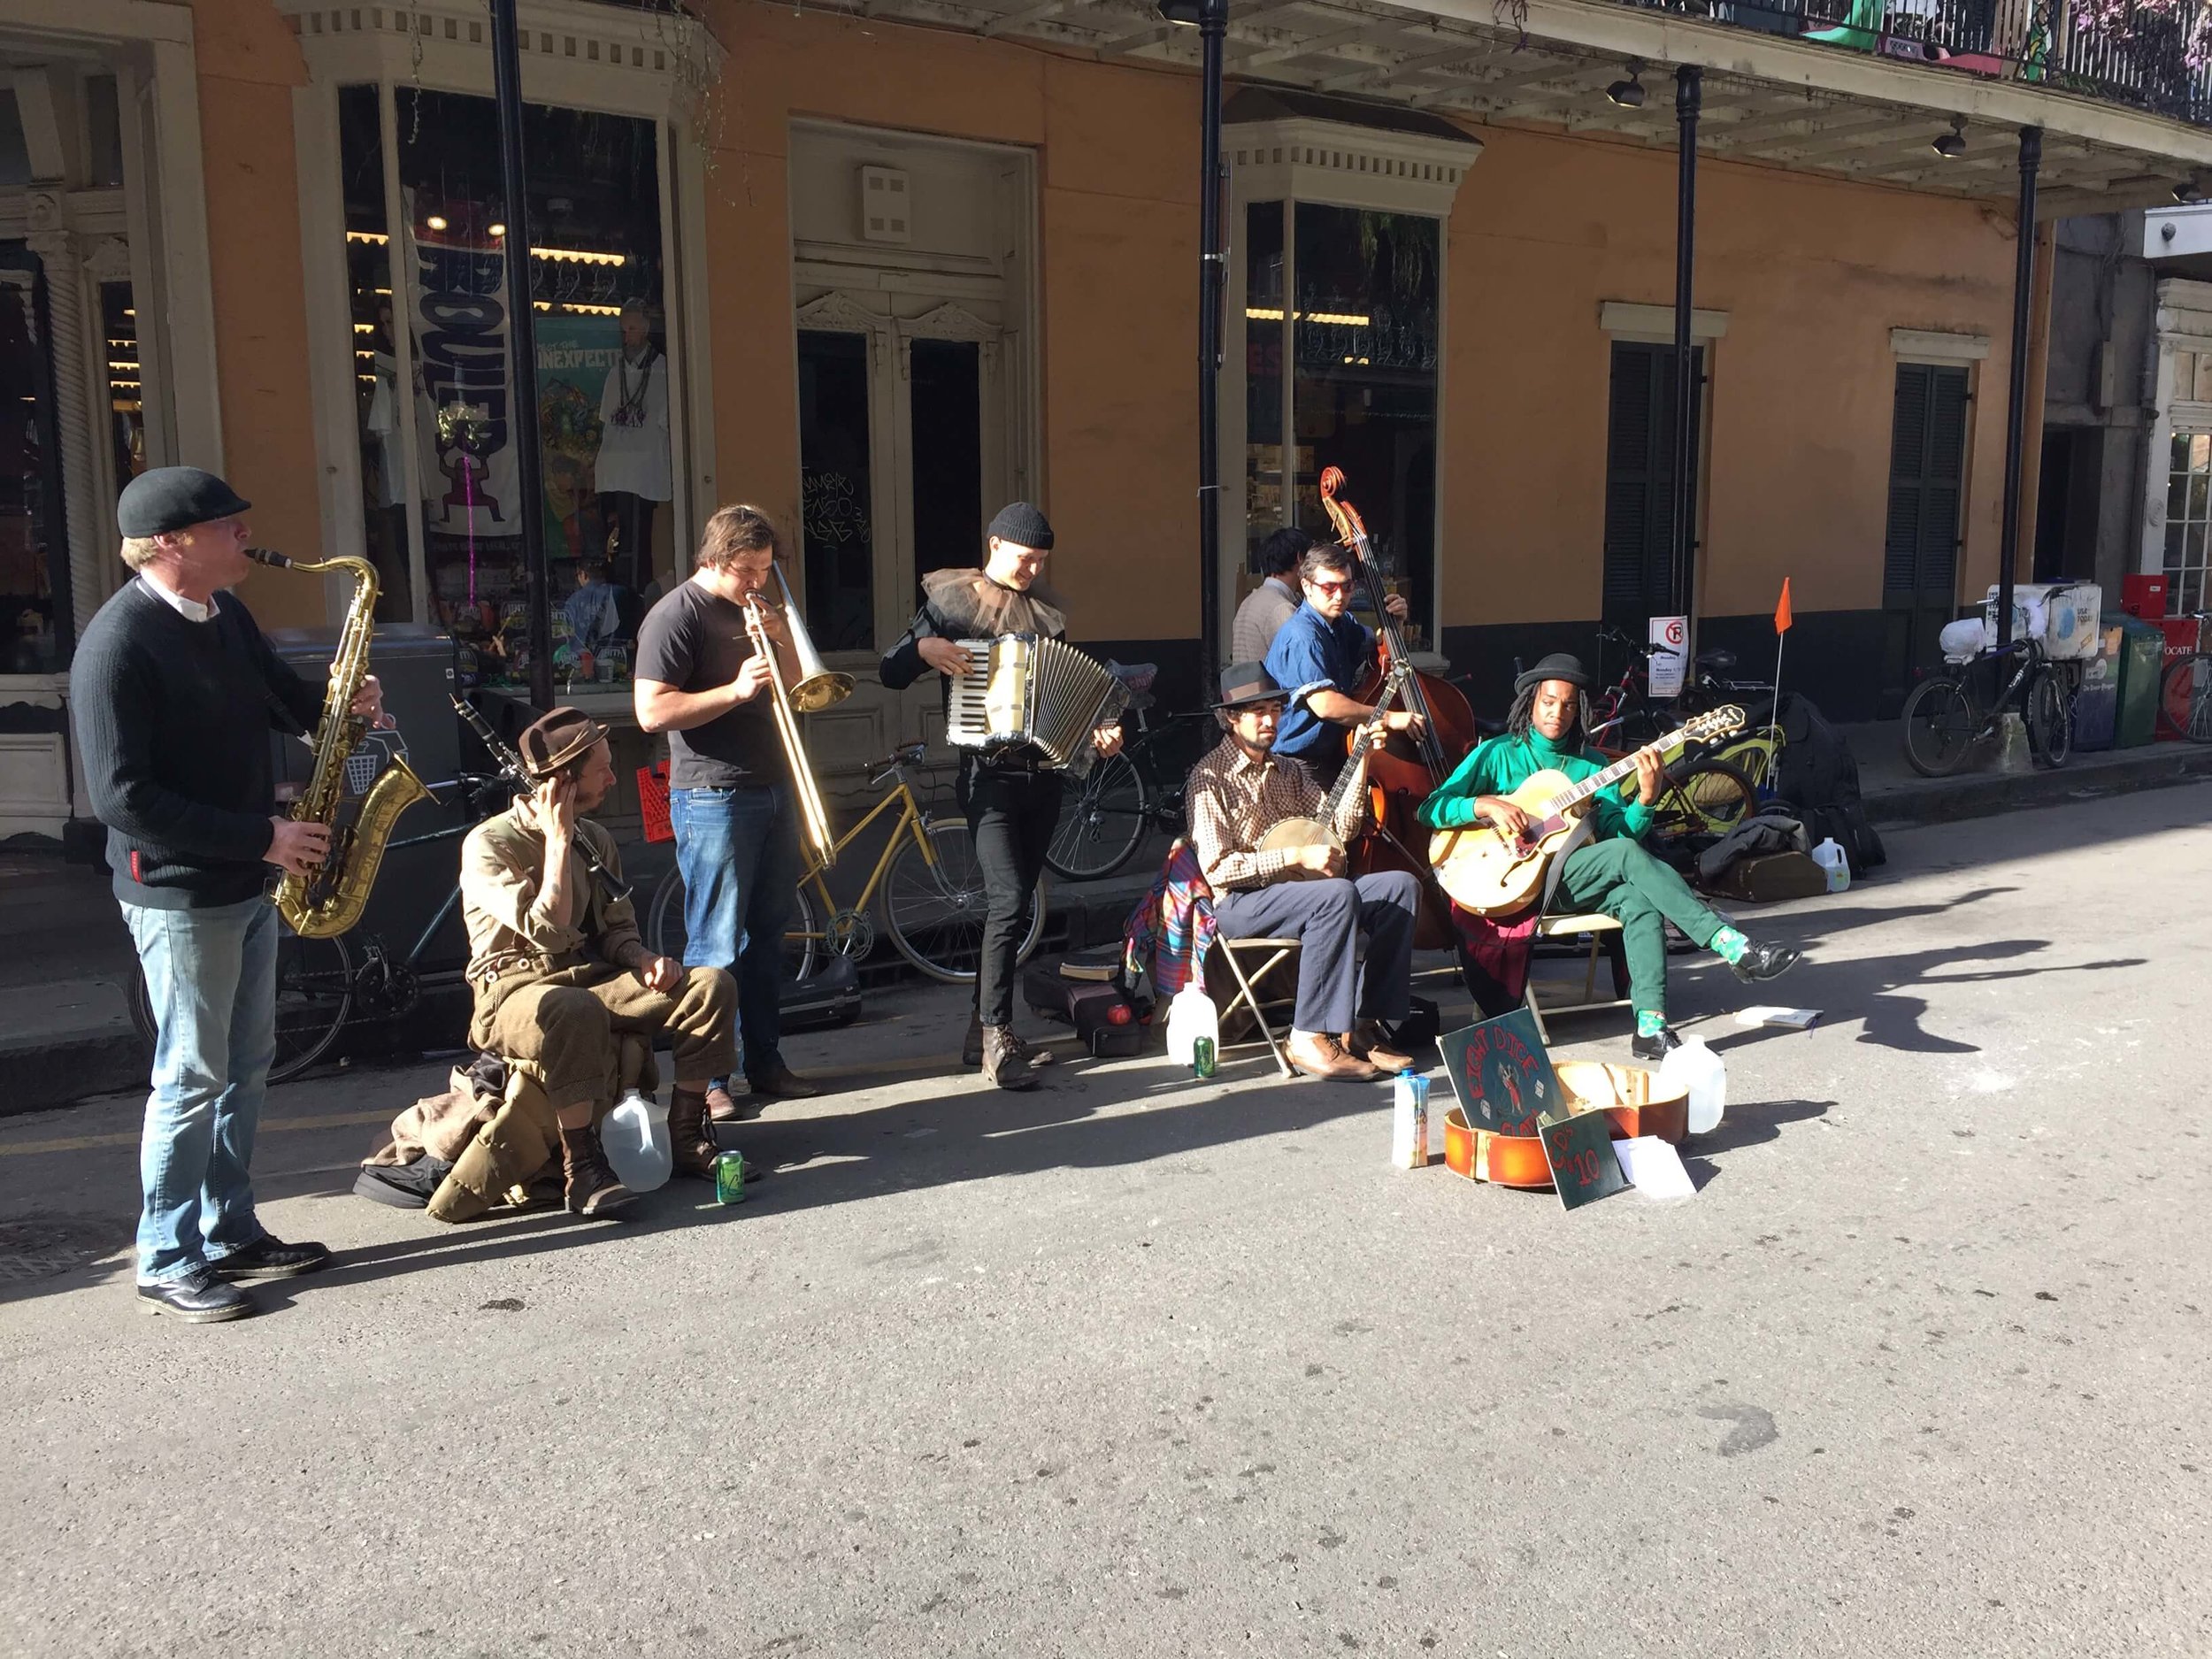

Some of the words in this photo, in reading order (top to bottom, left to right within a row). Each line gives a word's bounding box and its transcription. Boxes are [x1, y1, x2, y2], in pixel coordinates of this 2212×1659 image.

[2164, 646, 2193, 657] OCATE
[1466, 1027, 1489, 1099] EIGHT
[1494, 1025, 1539, 1078] DICE
